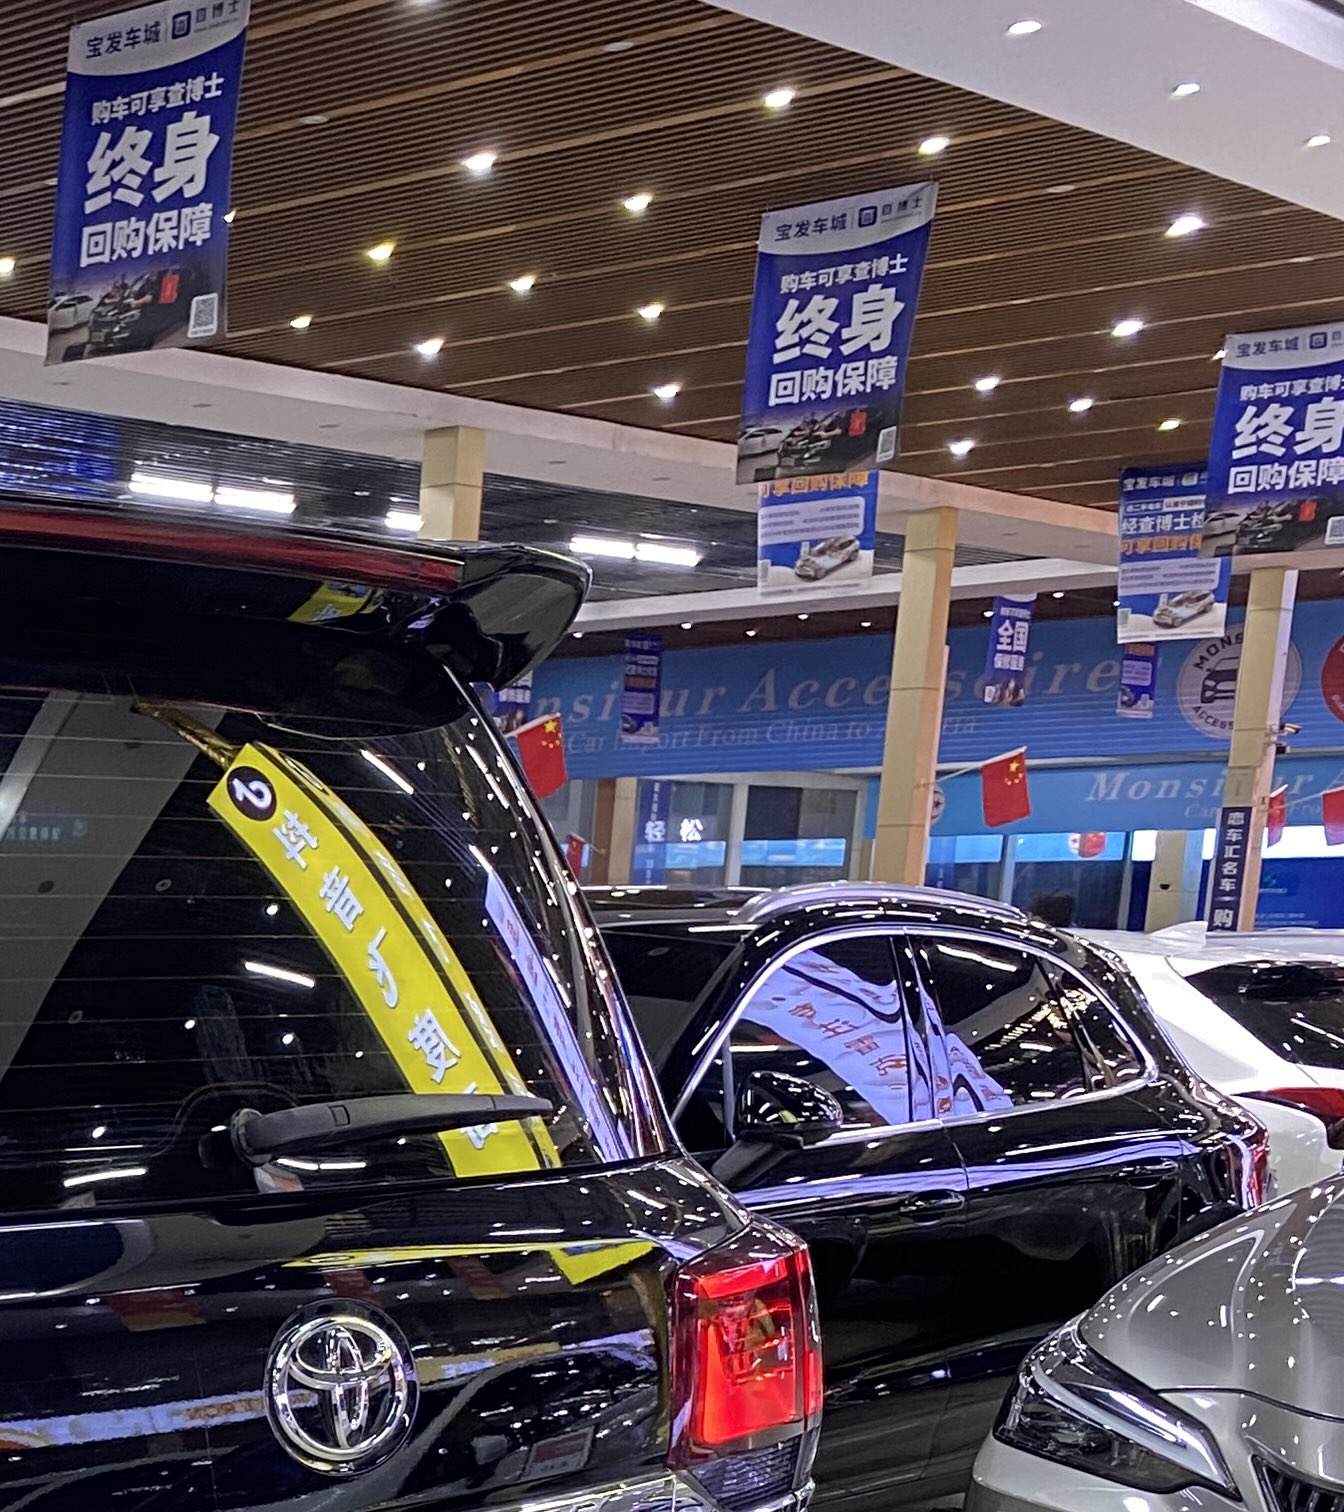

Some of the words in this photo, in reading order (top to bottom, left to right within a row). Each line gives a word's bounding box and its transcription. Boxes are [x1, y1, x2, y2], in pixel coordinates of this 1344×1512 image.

[85, 21, 161, 59] 宝发车城
[91, 72, 225, 125] 购车可享查博士
[84, 110, 220, 215] 终身
[80, 202, 213, 268] 回购保障
[775, 213, 848, 242] 宝发车城
[780, 253, 909, 294] 购车可享查博士
[773, 283, 905, 365] 终身
[768, 355, 898, 407] 回购保障
[1240, 374, 1344, 401] 购车可享查博
[1231, 397, 1344, 460] 终身
[1227, 456, 1344, 495] 回购保障
[996, 619, 1029, 653] 全国
